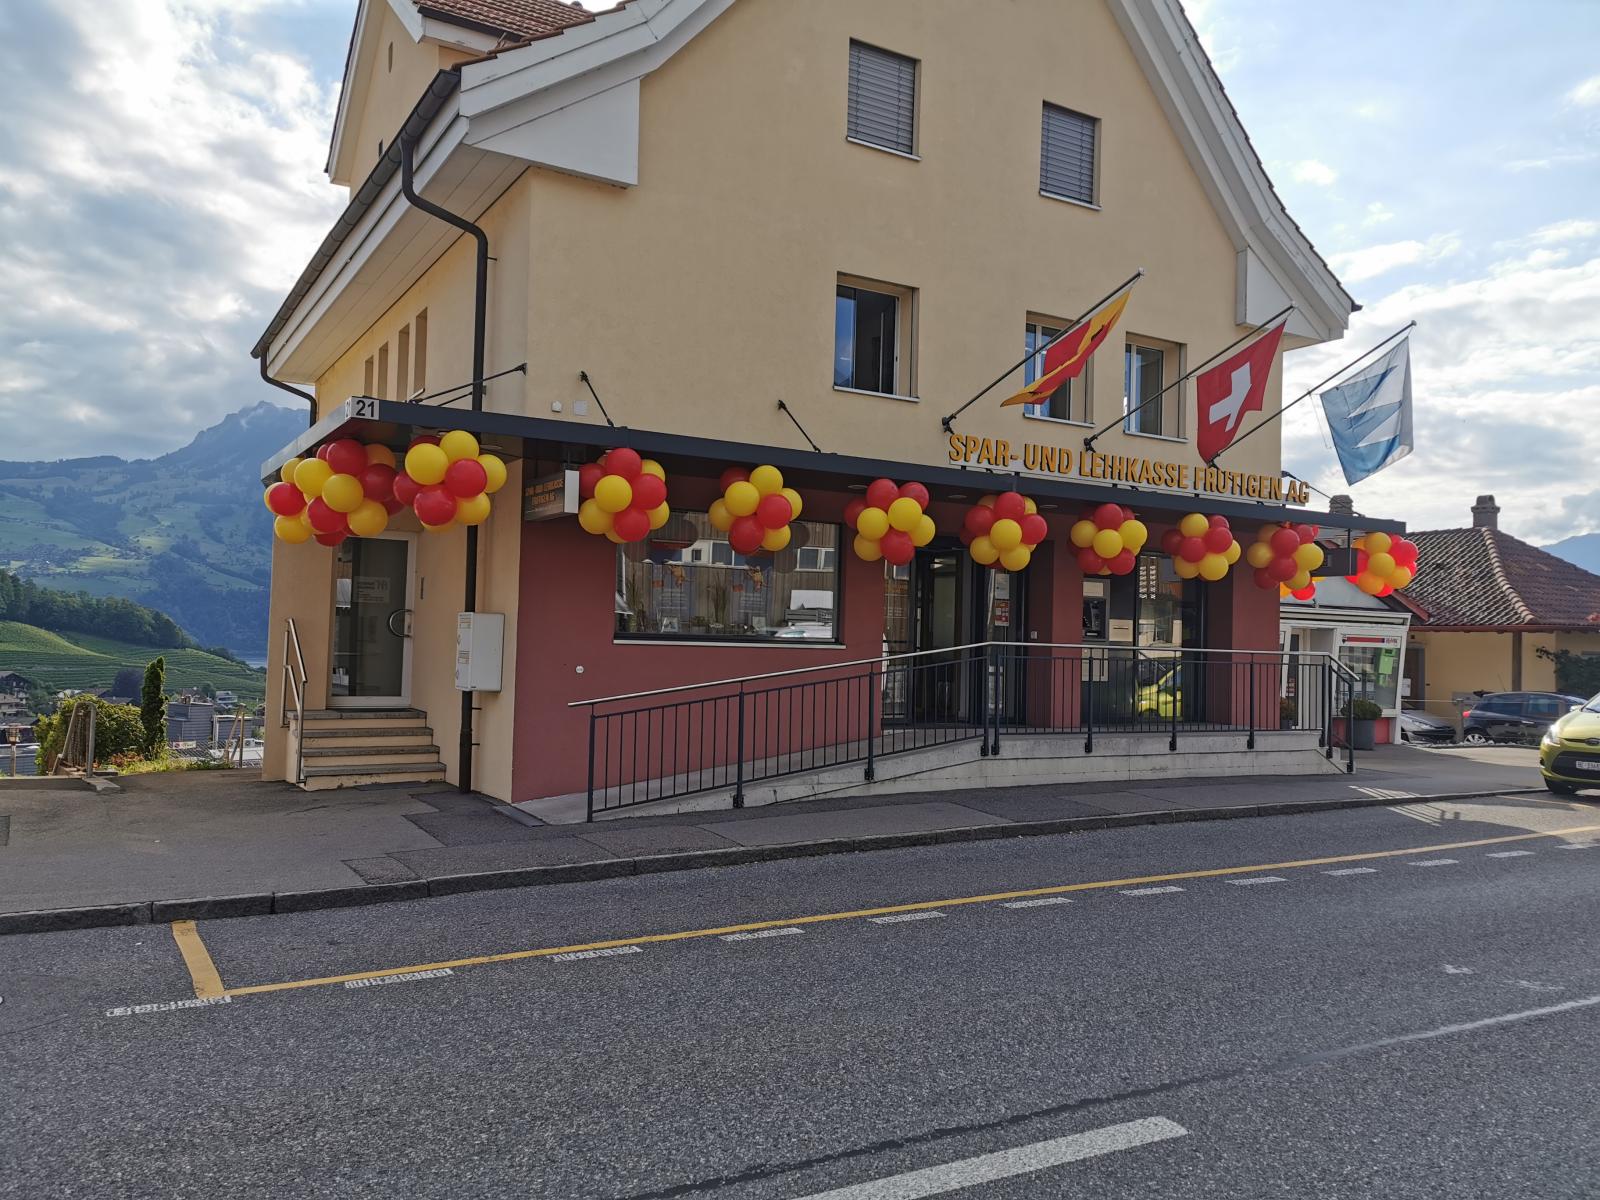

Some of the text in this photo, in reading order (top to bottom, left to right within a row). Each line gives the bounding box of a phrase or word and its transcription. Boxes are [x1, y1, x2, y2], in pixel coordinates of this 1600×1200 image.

[356, 399, 374, 417] 21
[949, 433, 1310, 503] SPAR- UND LEIHKASSE FRUTIGEN AG
